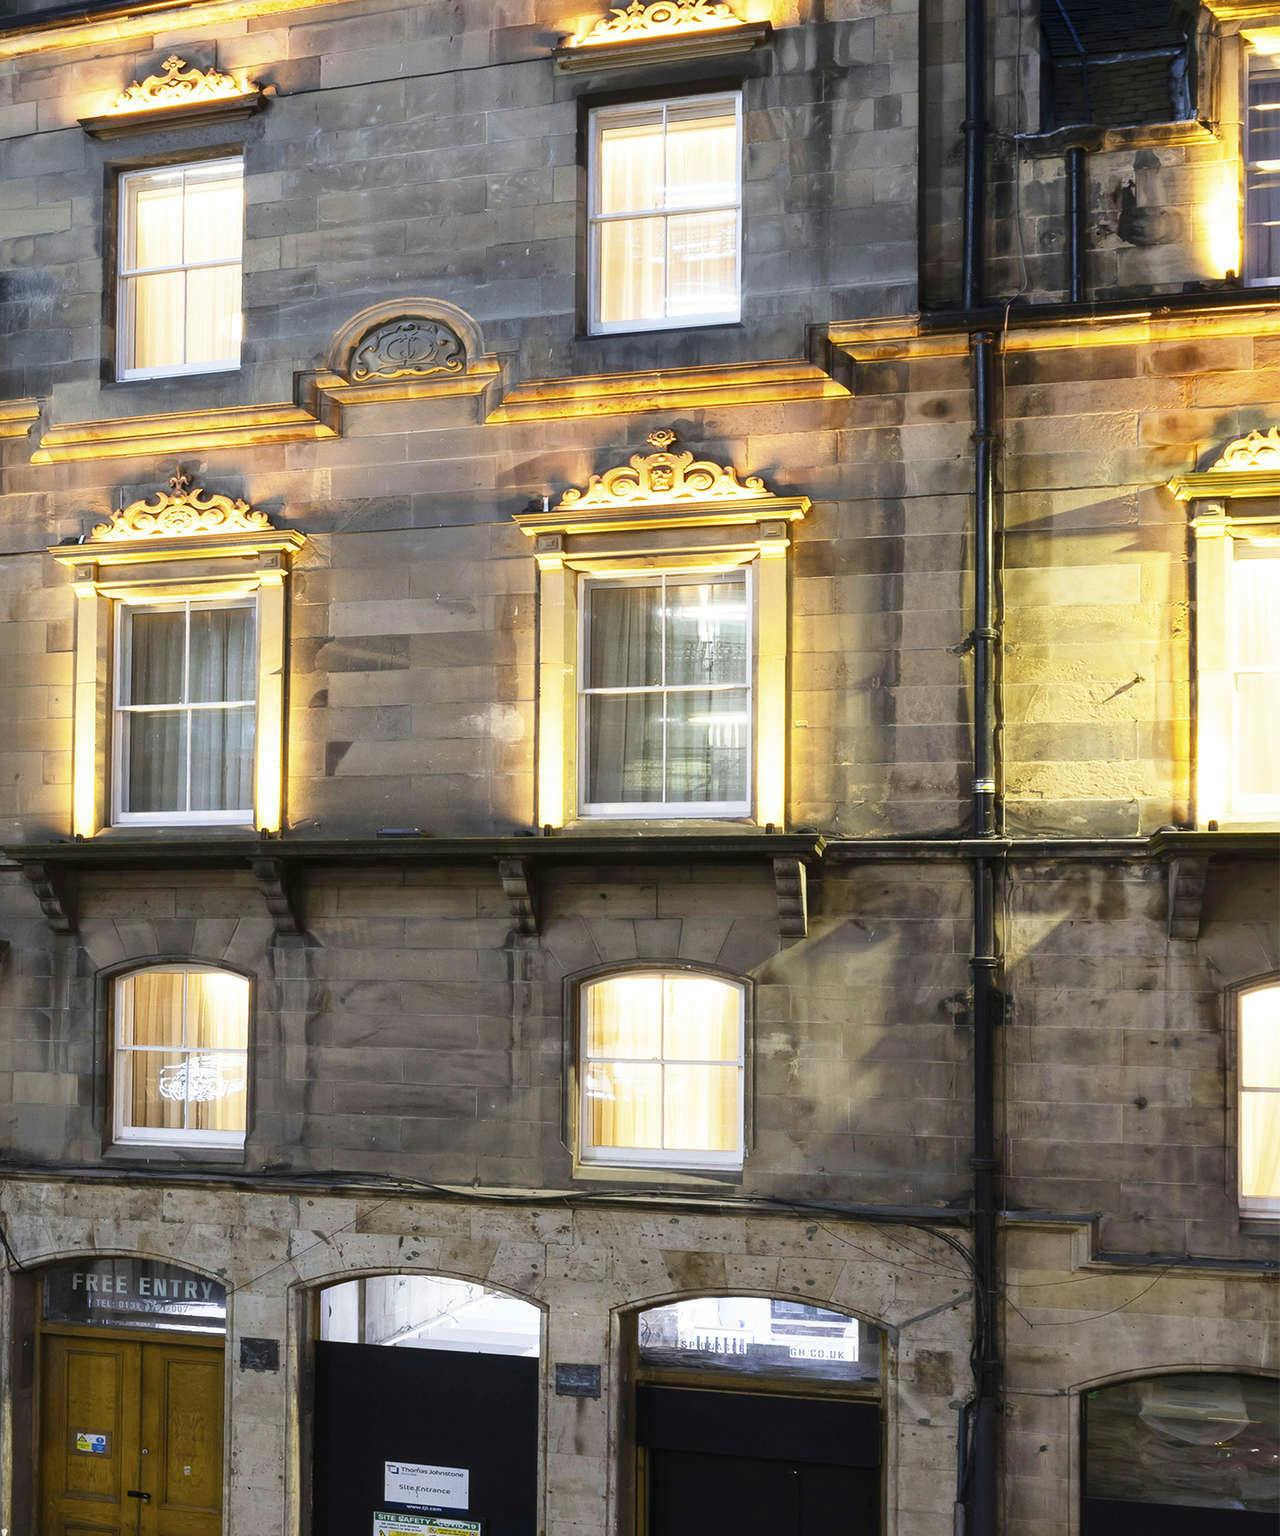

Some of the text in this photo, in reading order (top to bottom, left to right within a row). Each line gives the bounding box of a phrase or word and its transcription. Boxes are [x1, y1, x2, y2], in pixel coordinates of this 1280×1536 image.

[72, 1273, 213, 1299] FREE ENTRY
[401, 1466, 428, 1475] Thomas
[428, 1469, 464, 1478] Johnstone
[416, 1486, 451, 1495] Entrance
[377, 1513, 396, 1521] SITE
[398, 1515, 431, 1525] SAFETY
